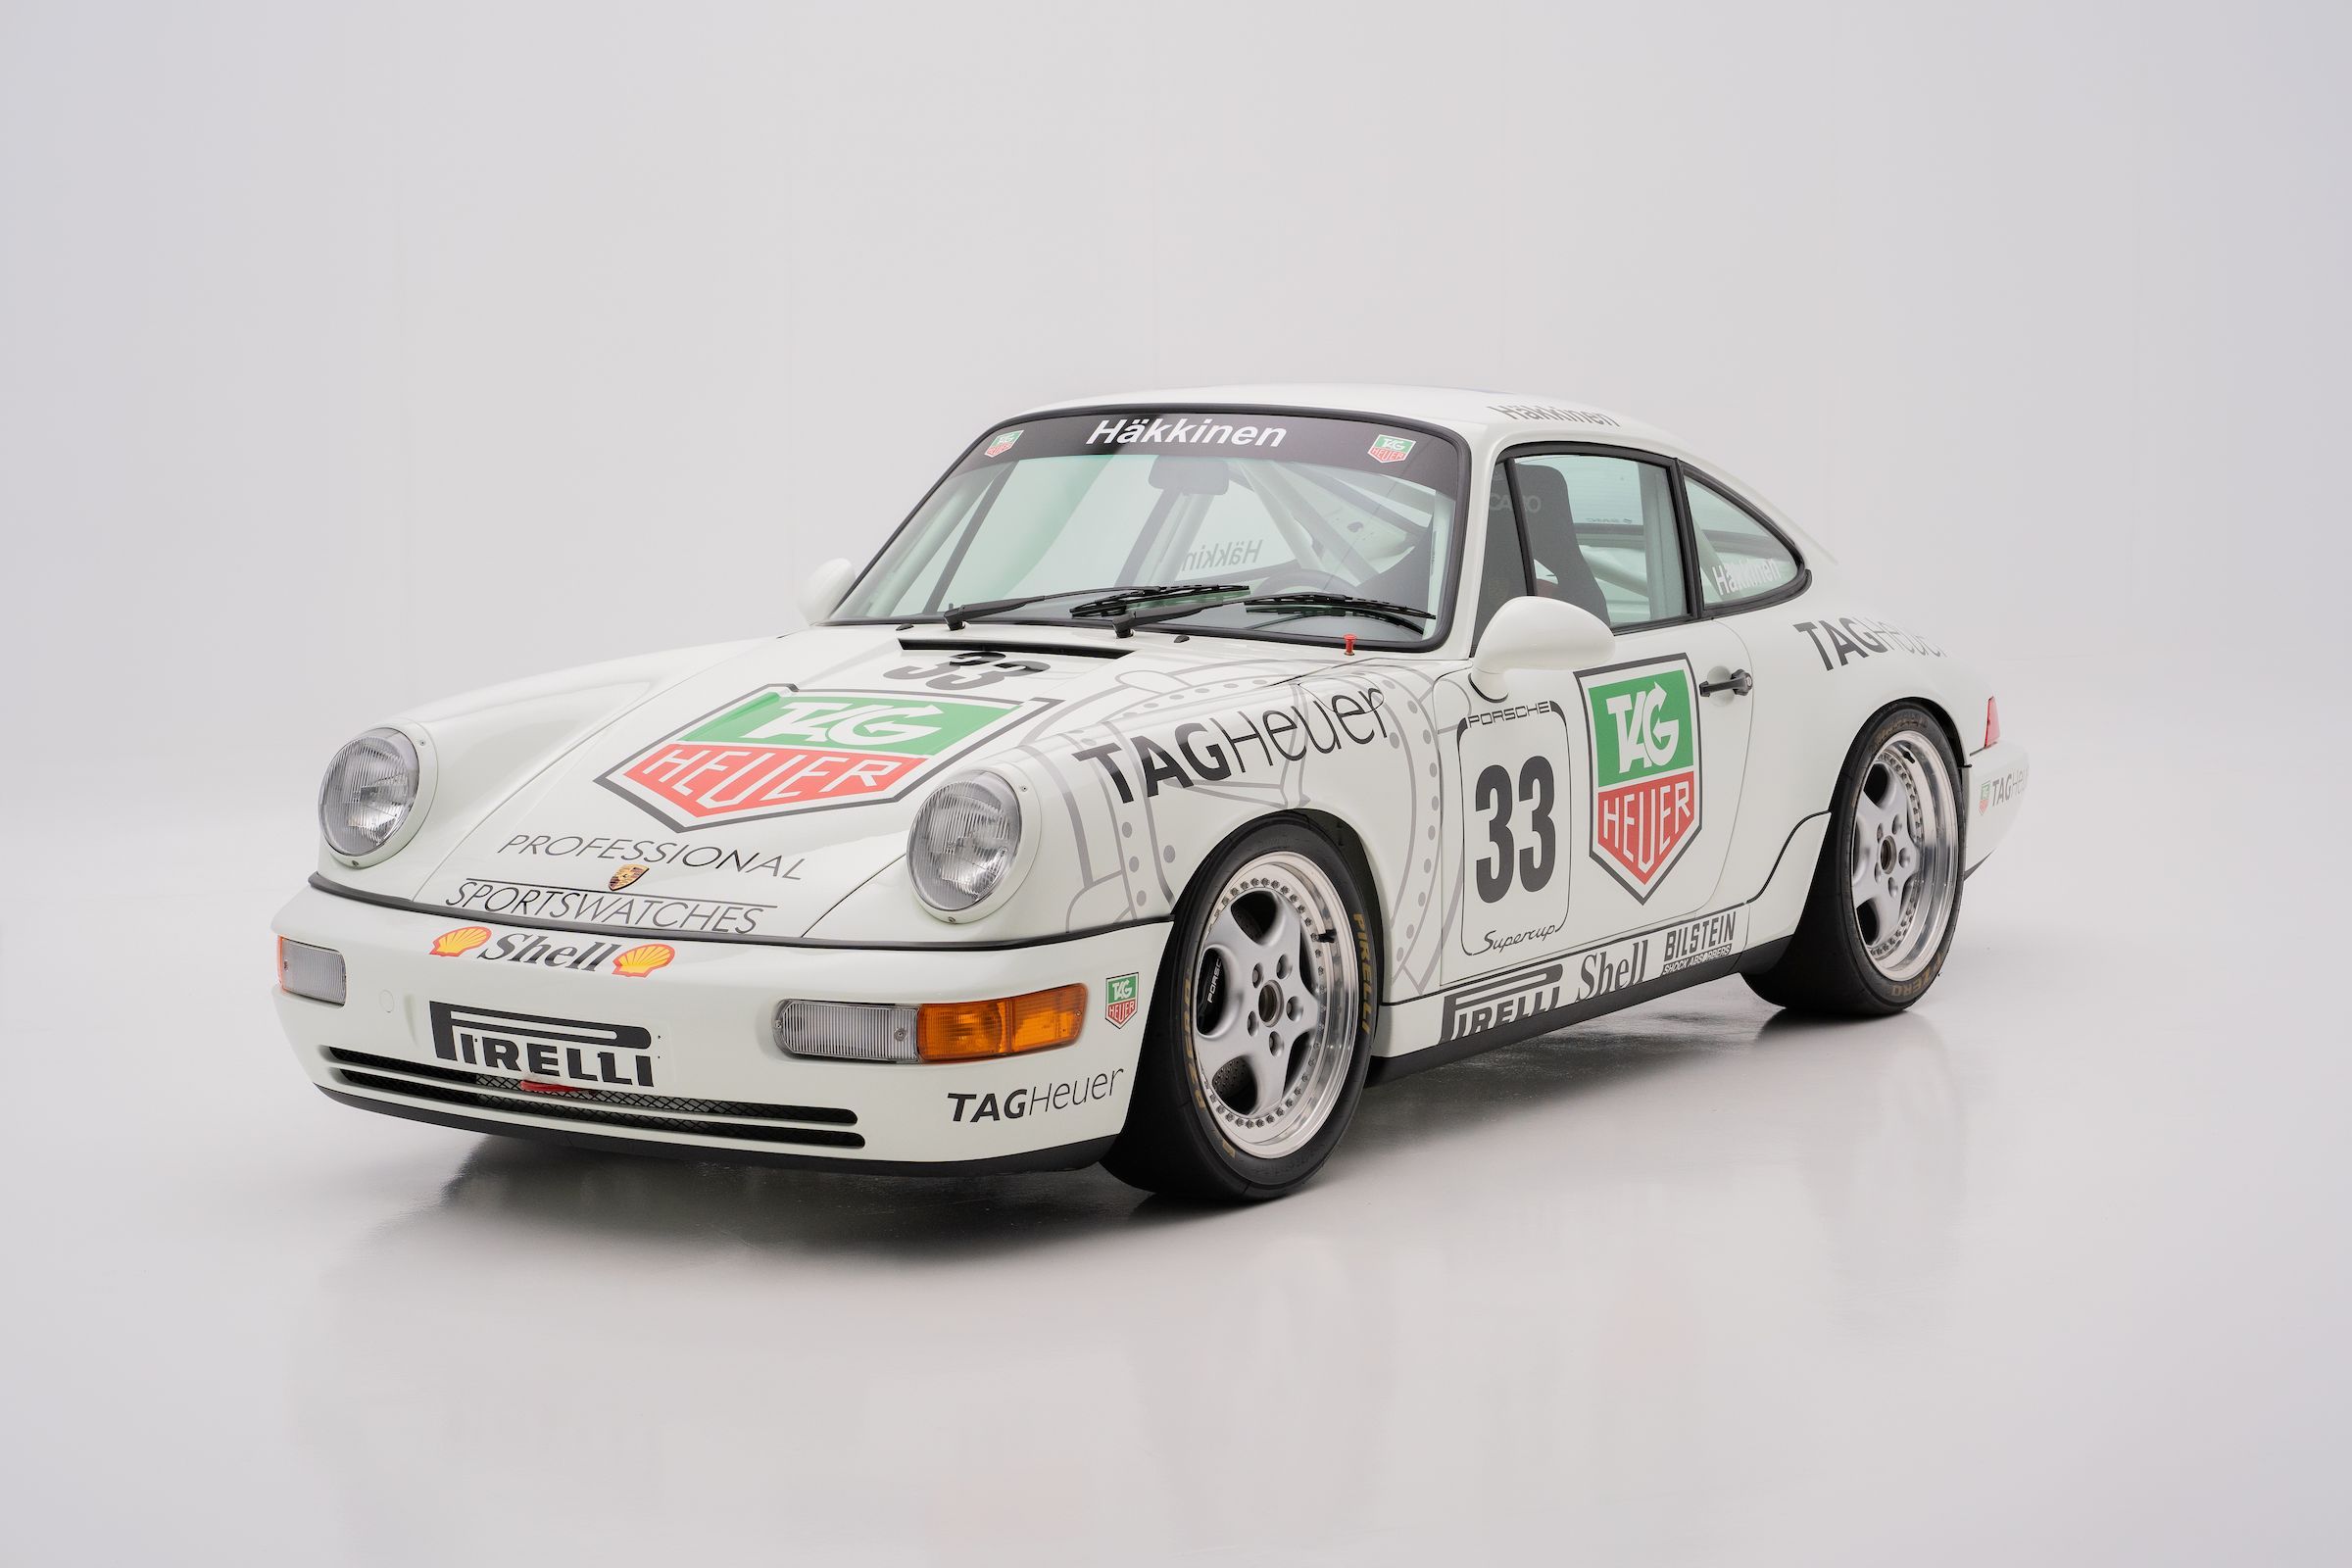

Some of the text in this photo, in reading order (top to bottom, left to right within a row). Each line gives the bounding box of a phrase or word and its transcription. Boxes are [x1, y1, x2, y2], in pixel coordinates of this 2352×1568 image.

[1086, 417, 1287, 447] Häkkinen
[1486, 405, 1621, 427] Häkkinen
[1371, 447, 1404, 462] HEUER
[883, 651, 1051, 690] 33
[740, 702, 943, 746] TAG
[1467, 701, 1551, 728] PORSCHE
[1606, 681, 1680, 773] TAG
[642, 749, 906, 808] HEUER
[1475, 755, 1556, 904] 33
[1603, 781, 1691, 874] HEUER
[497, 834, 807, 880] PROFESSIONAL
[445, 881, 764, 934] SPORTSWATCHES
[478, 933, 621, 973] Shell
[1482, 923, 1556, 953] Supercup
[1664, 911, 1736, 961] BILSTEIN
[1353, 913, 1372, 1035] PIRELLI
[1576, 939, 1648, 1003] Shell
[1662, 957, 1689, 976] SHOCK
[1112, 978, 1132, 1001] TAG
[1438, 963, 1563, 1045] PIRELLI
[1108, 1001, 1135, 1024] HEUER
[429, 1001, 656, 1087] PIRELLI
